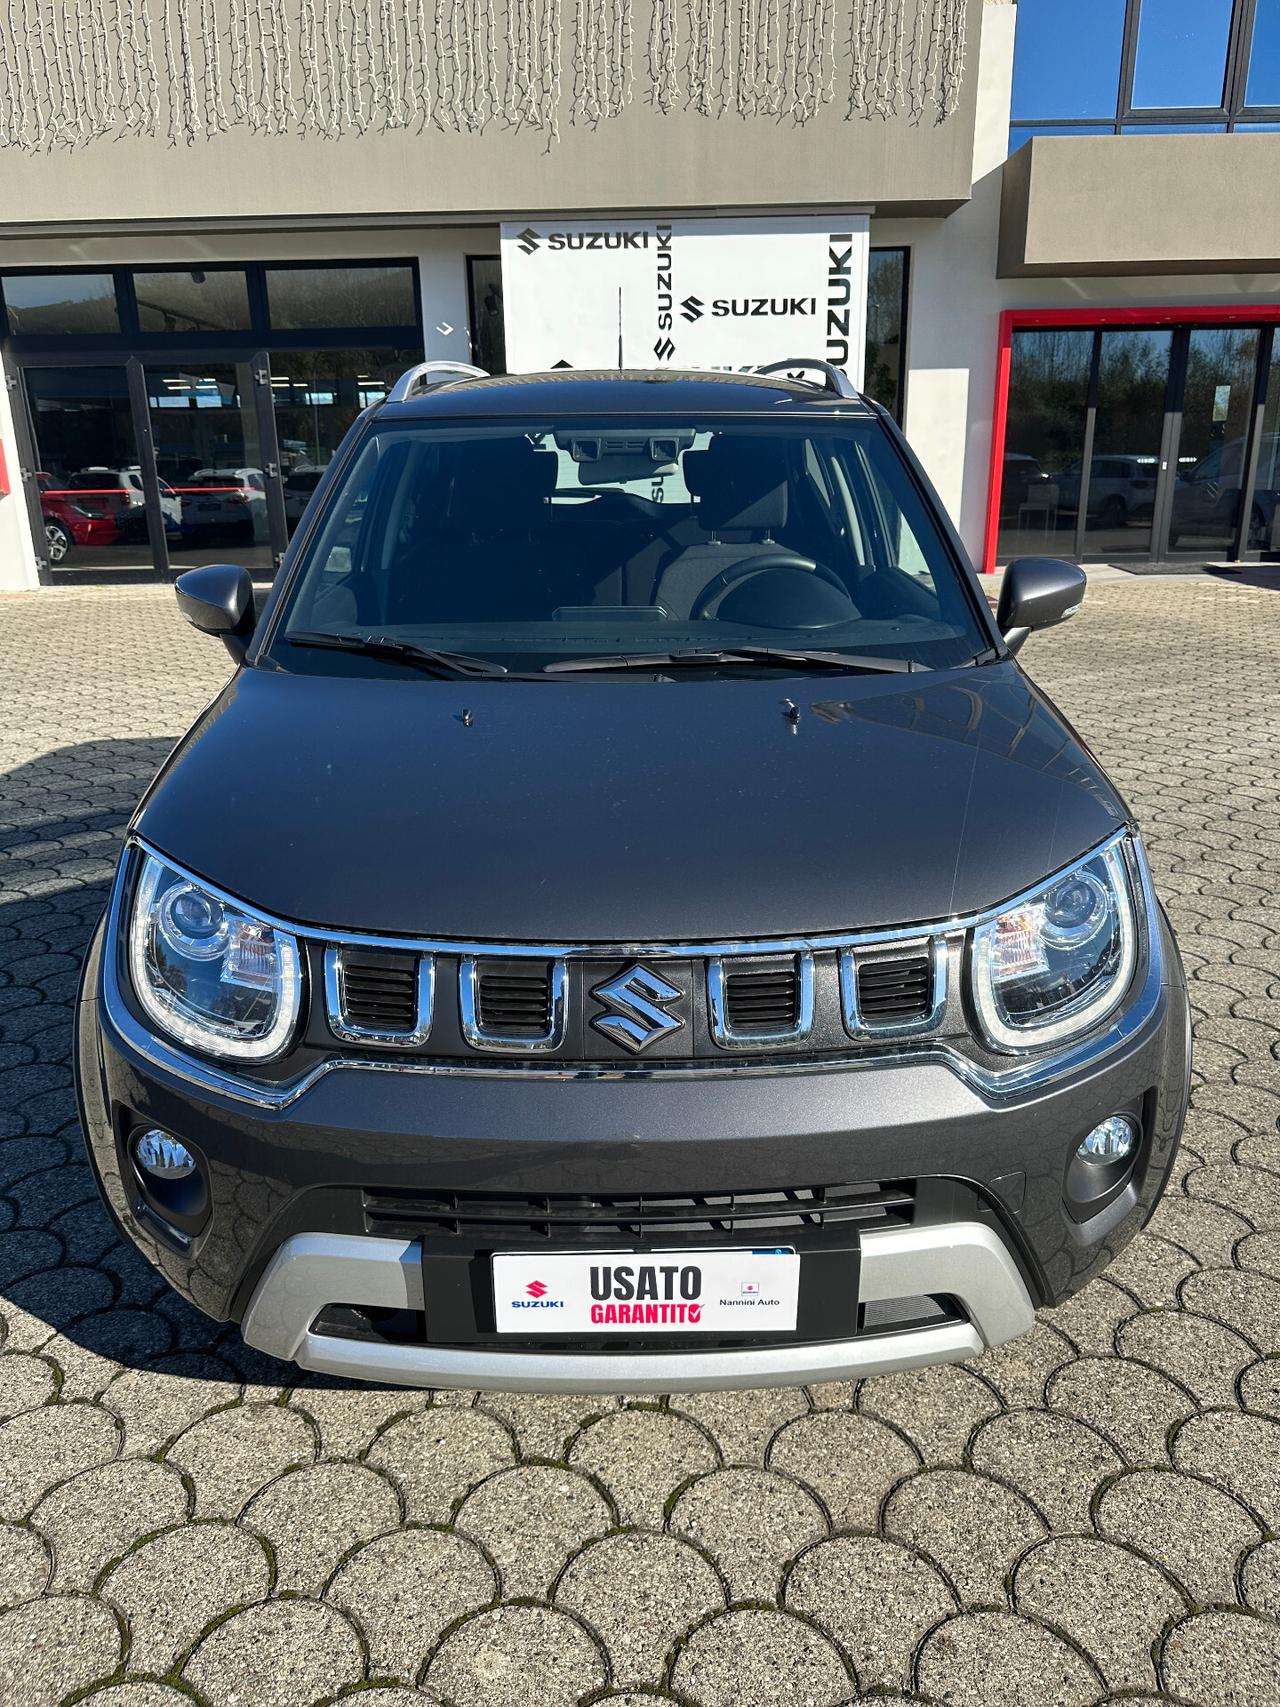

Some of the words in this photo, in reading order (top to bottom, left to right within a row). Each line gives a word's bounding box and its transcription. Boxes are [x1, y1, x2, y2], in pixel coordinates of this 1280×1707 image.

[548, 231, 649, 250] SUZUKI
[656, 224, 673, 331] SUZUKI
[711, 297, 817, 317] SUZUKI
[826, 233, 853, 381] UZUKI
[589, 1265, 702, 1301] USATO
[511, 1300, 565, 1309] SUZUKI
[590, 1303, 704, 1324] GARANTITO
